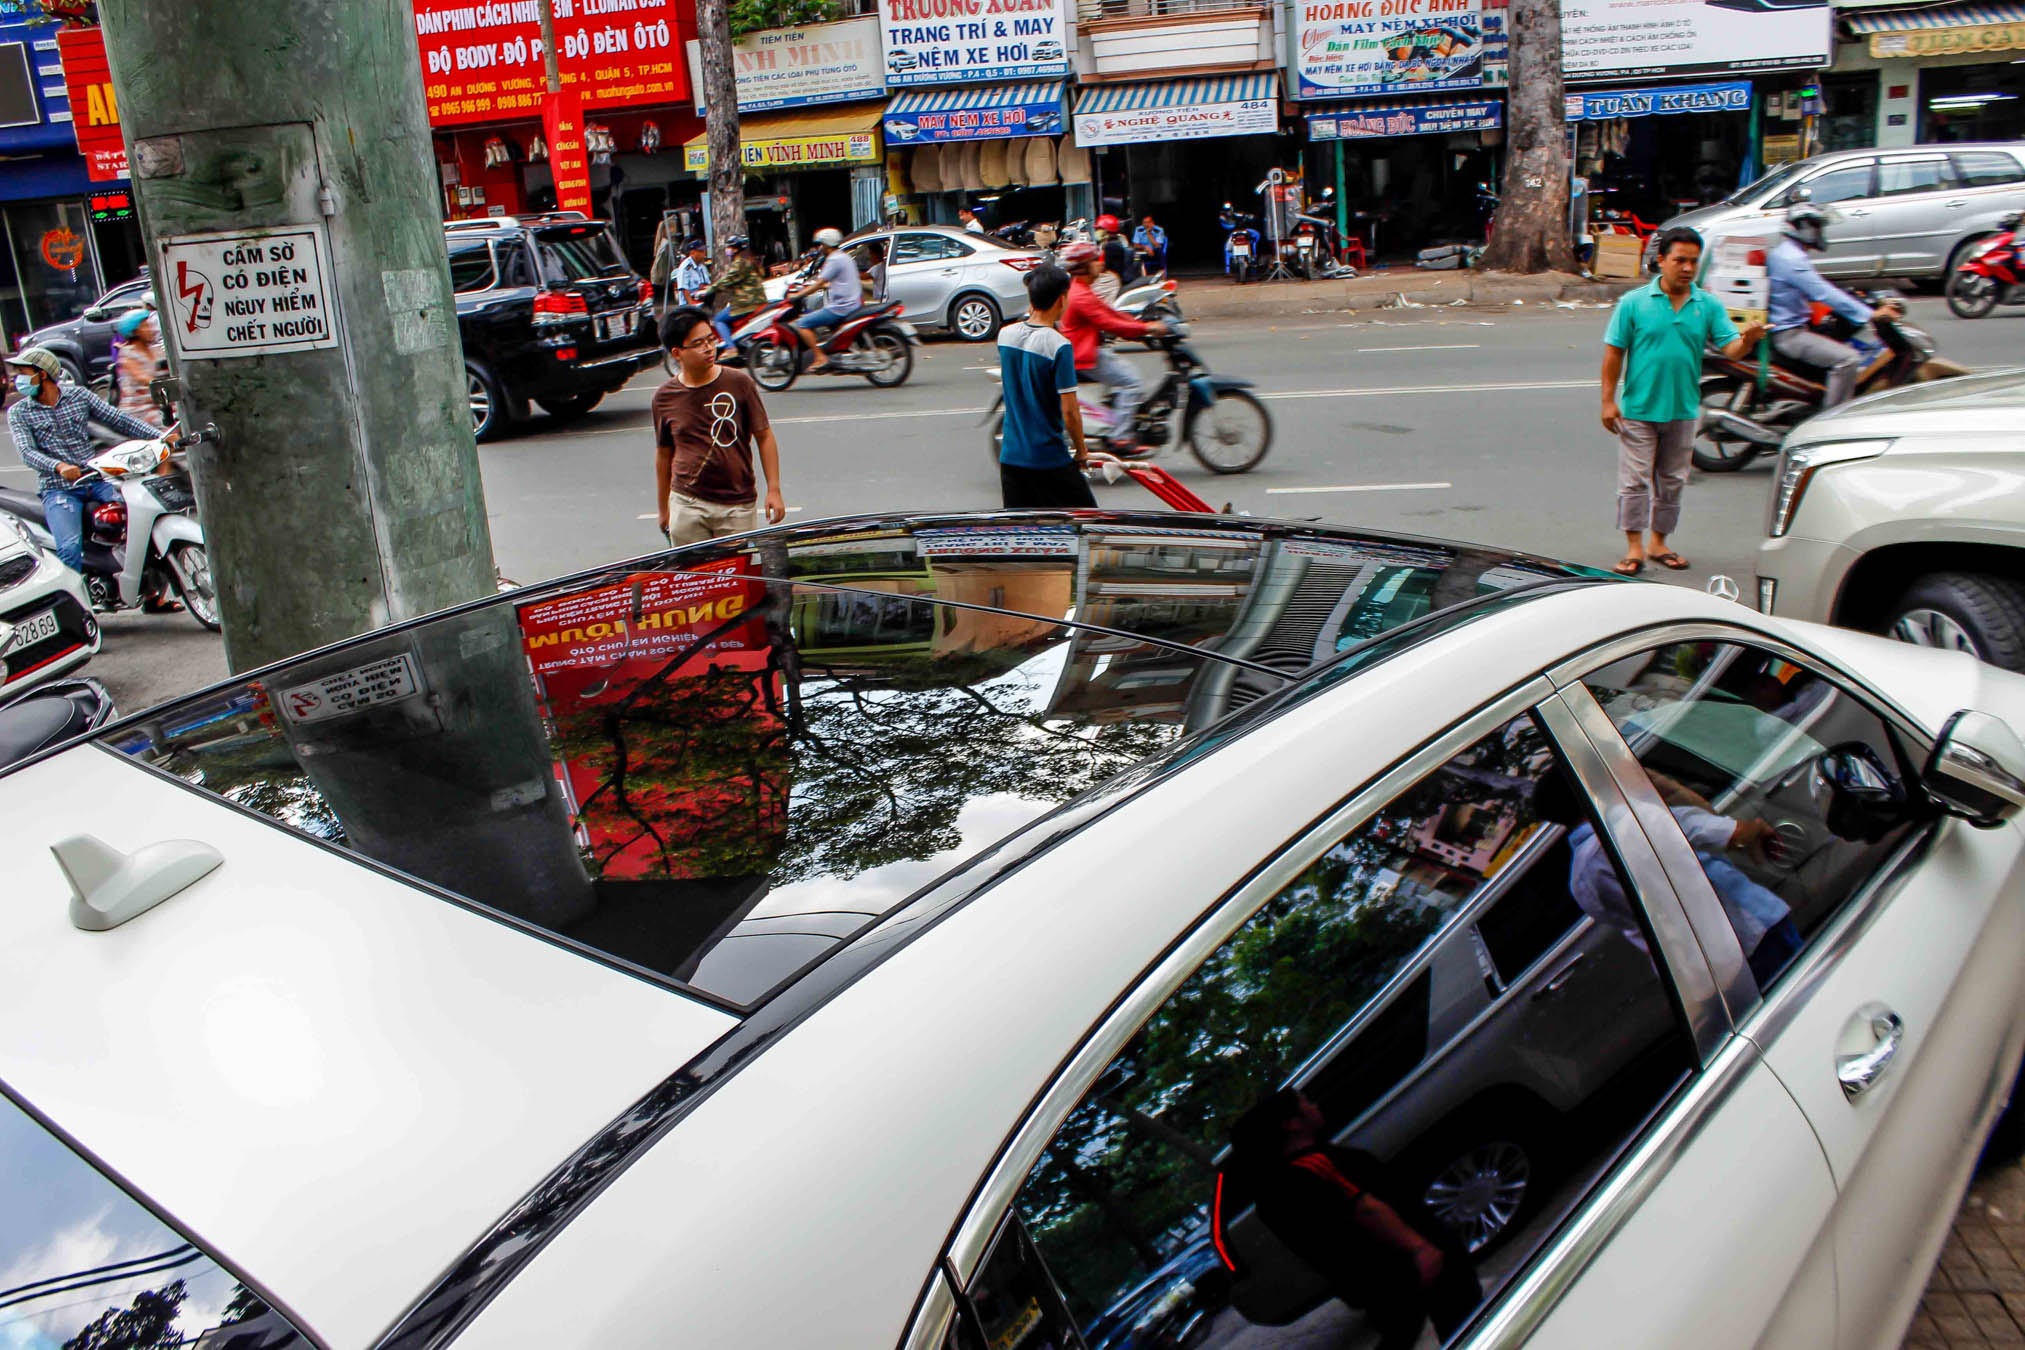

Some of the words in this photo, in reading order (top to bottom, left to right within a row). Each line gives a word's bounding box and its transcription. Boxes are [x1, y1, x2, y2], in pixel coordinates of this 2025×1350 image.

[416, 7, 443, 35] DÁN
[443, 8, 476, 32] PHIM
[476, 1, 511, 28] CÁCH
[553, 0, 574, 19] 3M
[1341, 22, 1377, 35] MAY
[1448, 14, 1477, 26] HƠI
[888, 25, 950, 45] TRANG
[955, 18, 987, 40] TRÍ
[993, 20, 1008, 37] &
[1014, 17, 1054, 36] MAY
[428, 45, 452, 75] ĐỘ
[456, 43, 498, 71] BODY
[564, 28, 589, 59] ĐỘ
[593, 25, 628, 54] ĐÈN
[634, 18, 670, 50] ÔTÔ
[918, 46, 959, 70] NỆM
[966, 47, 989, 64] XE
[997, 42, 1029, 62] HƠI
[427, 84, 447, 99] 490
[1660, 89, 1748, 111] KHANG
[1240, 100, 1268, 110] 484
[1425, 107, 1464, 119] CHUYÊN
[918, 115, 946, 129] MAY
[982, 111, 1000, 126] XE
[1003, 108, 1026, 124] HƠI
[1166, 112, 1220, 125] QUANG
[1386, 111, 1416, 134] ĐỨC
[766, 141, 802, 162] VĨNH
[806, 141, 846, 160] MINH
[269, 241, 295, 262] SỜ
[222, 269, 249, 290] CÓ
[256, 265, 307, 288] ĐIỆN
[224, 298, 266, 317] NGUY
[272, 287, 317, 313] HIỂM
[227, 319, 266, 342] CHẾT
[272, 316, 323, 338] NGƯỜI
